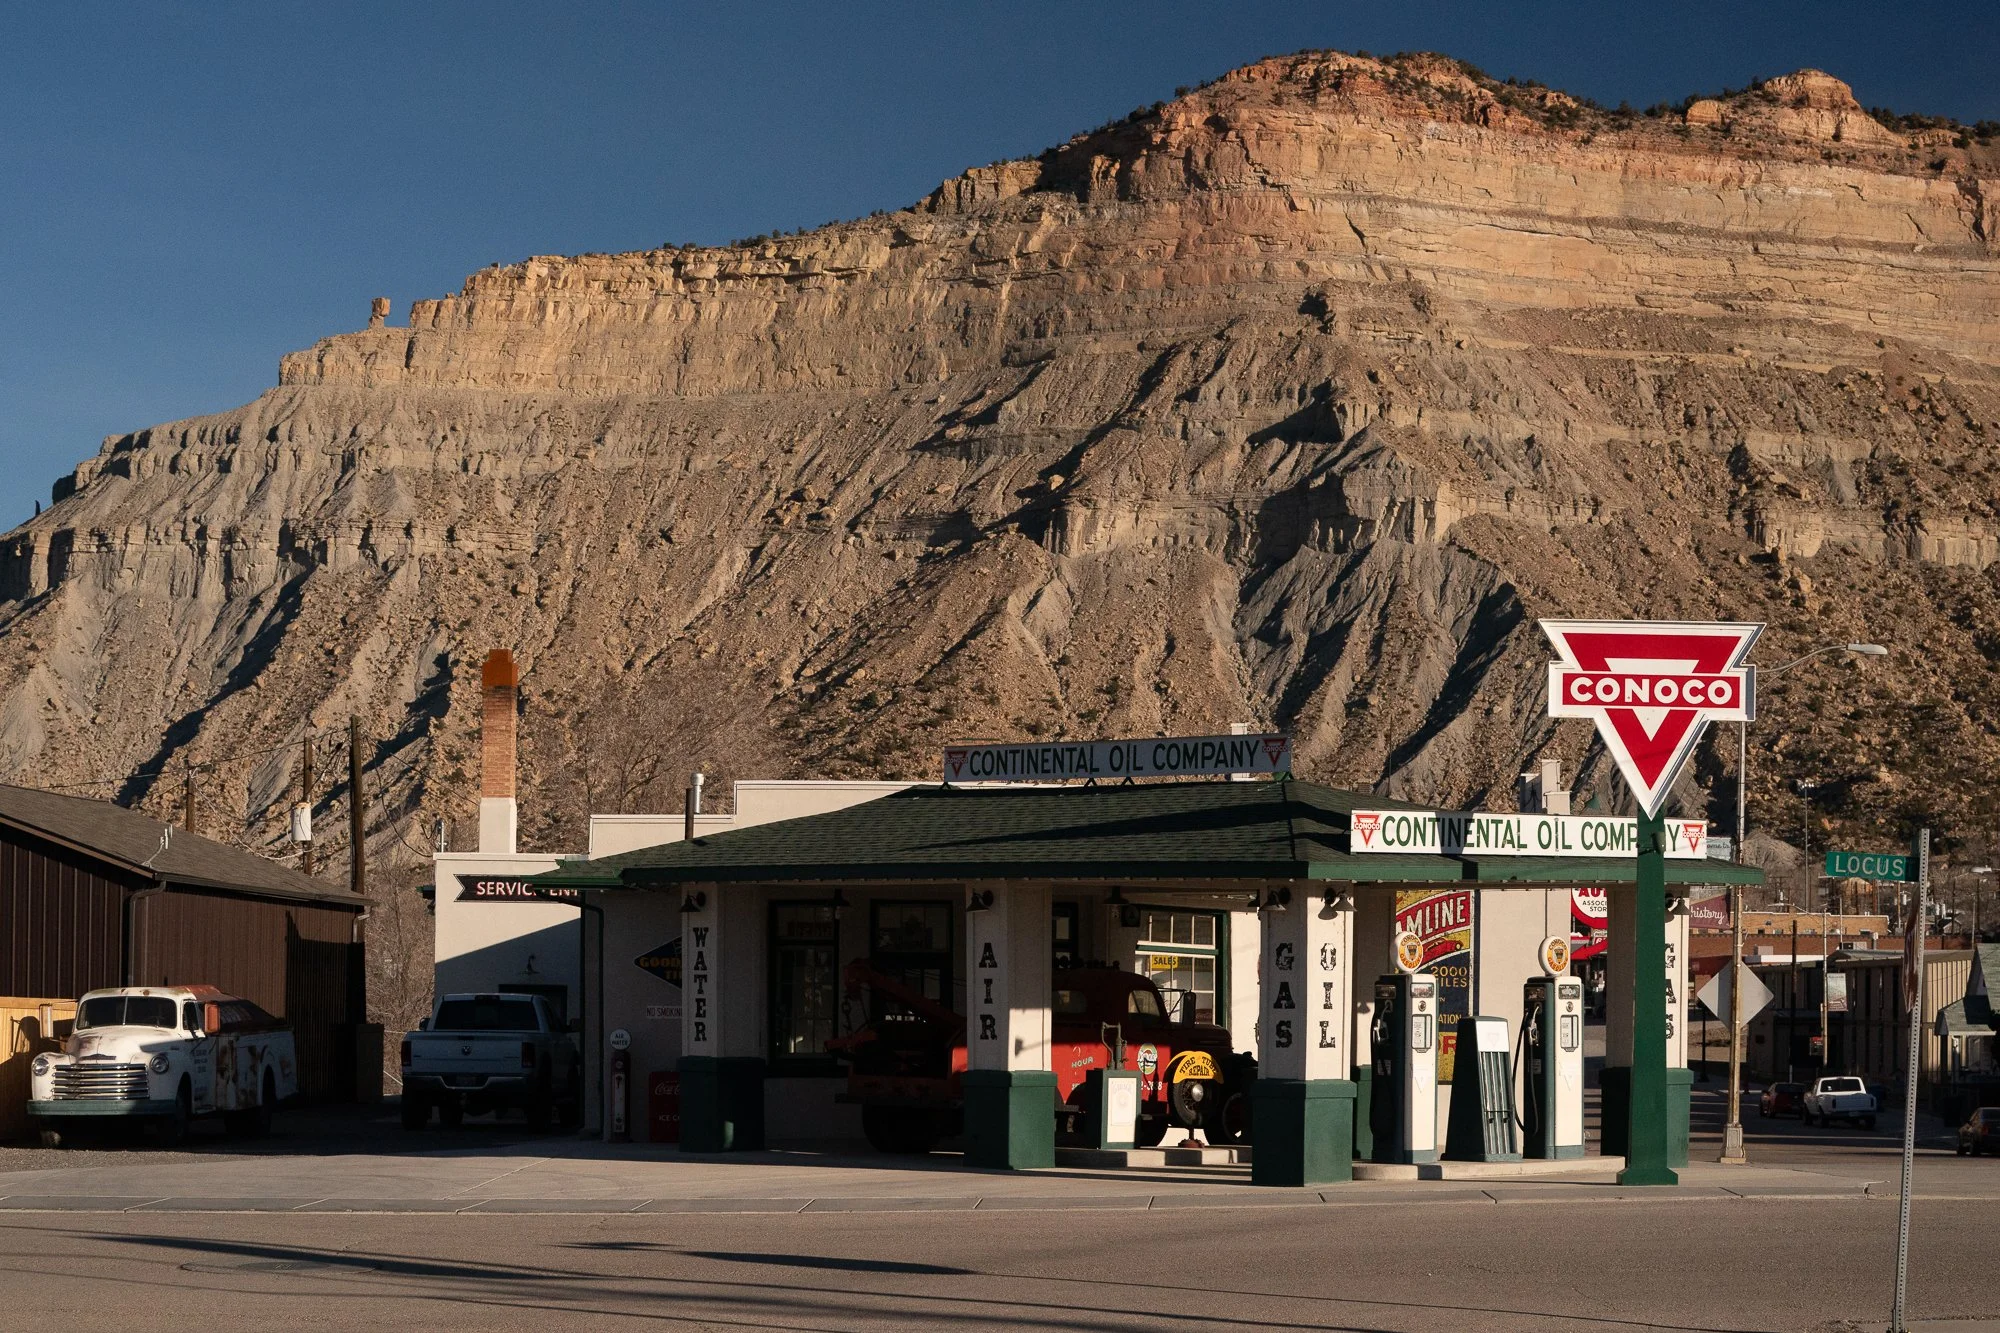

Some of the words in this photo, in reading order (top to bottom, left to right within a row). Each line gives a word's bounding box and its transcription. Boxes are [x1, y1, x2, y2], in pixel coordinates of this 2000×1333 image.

[1570, 678, 1733, 705] CONOCO
[969, 745, 1100, 777] CONTINENTAL
[1109, 743, 1143, 774] OIL
[1152, 739, 1260, 771] COMPANY
[1354, 822, 1380, 830] CONOCO
[1382, 815, 1527, 849] CONTINENTAL
[1537, 820, 1572, 850] OIL
[1581, 821, 1680, 852] COMPY
[476, 881, 537, 896] SERVIC
[1690, 905, 1725, 925] history
[1153, 956, 1177, 965] SALES
[1430, 966, 1467, 977] 2000
[693, 927, 709, 1041] WATER
[978, 942, 998, 1040] AIR
[1437, 977, 1468, 988] ILES
[1273, 942, 1296, 1048] GAS
[1319, 942, 1336, 1048] OIL
[646, 1007, 655, 1017] NO
[657, 1007, 682, 1017] SMOKIN
[1071, 1056, 1094, 1068] HOUR
[1179, 1056, 1196, 1075] TIRE
[1201, 1056, 1219, 1075] TUBE
[1188, 1066, 1210, 1076] REPAIR
